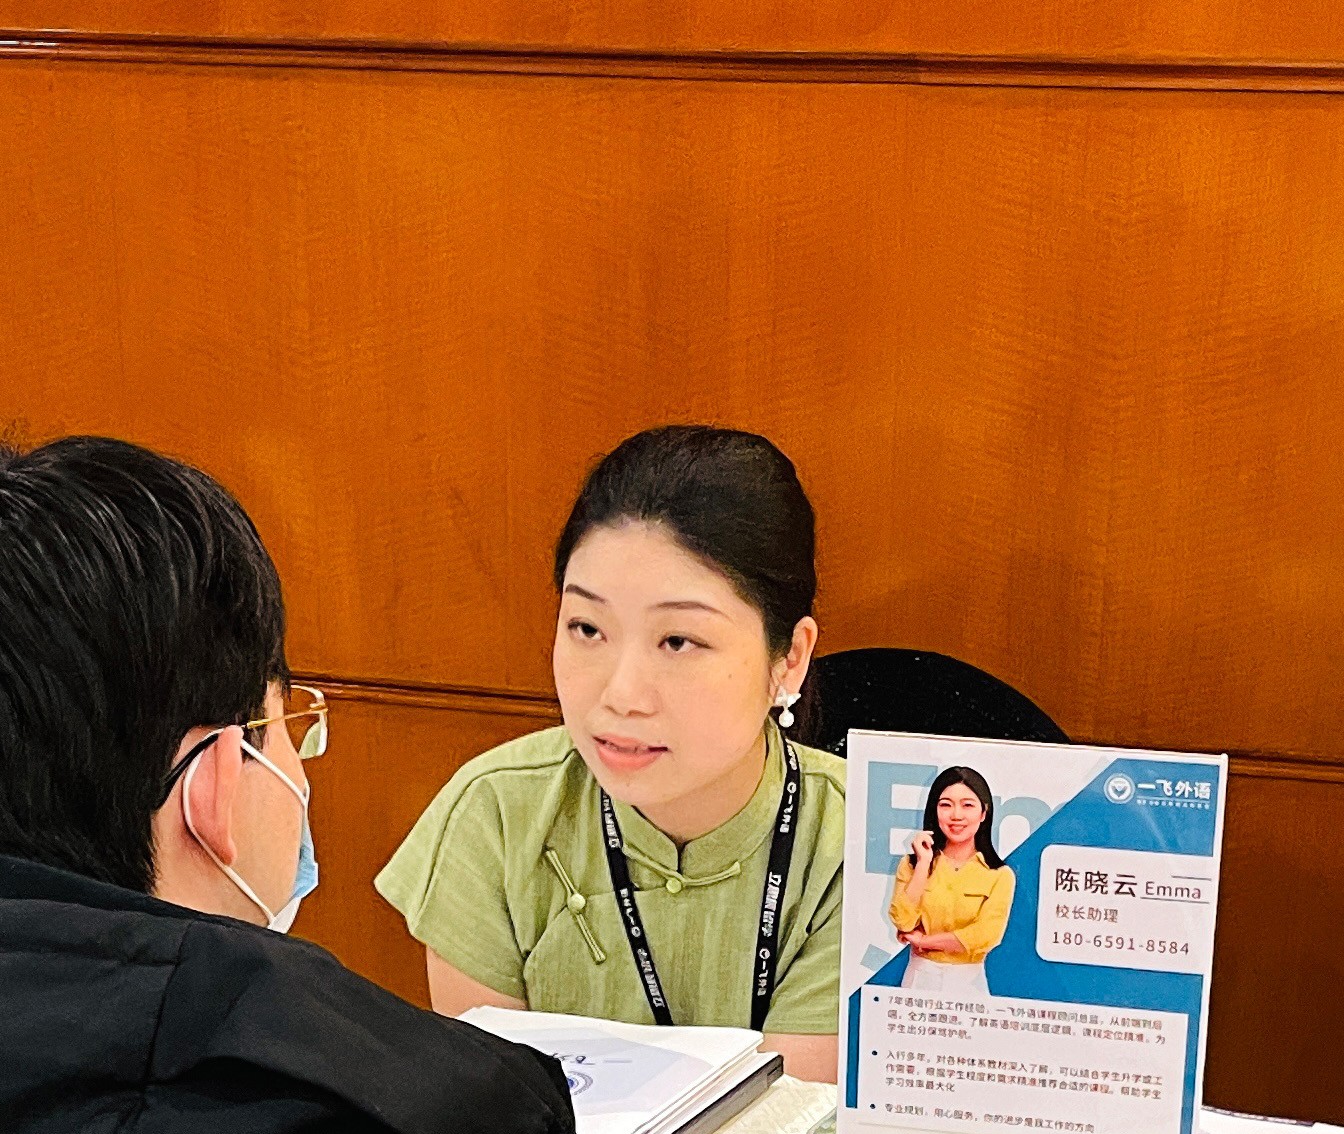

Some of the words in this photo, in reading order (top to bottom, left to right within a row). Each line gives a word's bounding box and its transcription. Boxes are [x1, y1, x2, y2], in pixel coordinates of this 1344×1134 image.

[1137, 779, 1212, 800] 一飞外语
[1055, 867, 1139, 898] 陈晓云
[1144, 880, 1202, 900] Emma
[1055, 903, 1119, 924] 校长助理
[1052, 930, 1190, 957] 180-6591-8584
